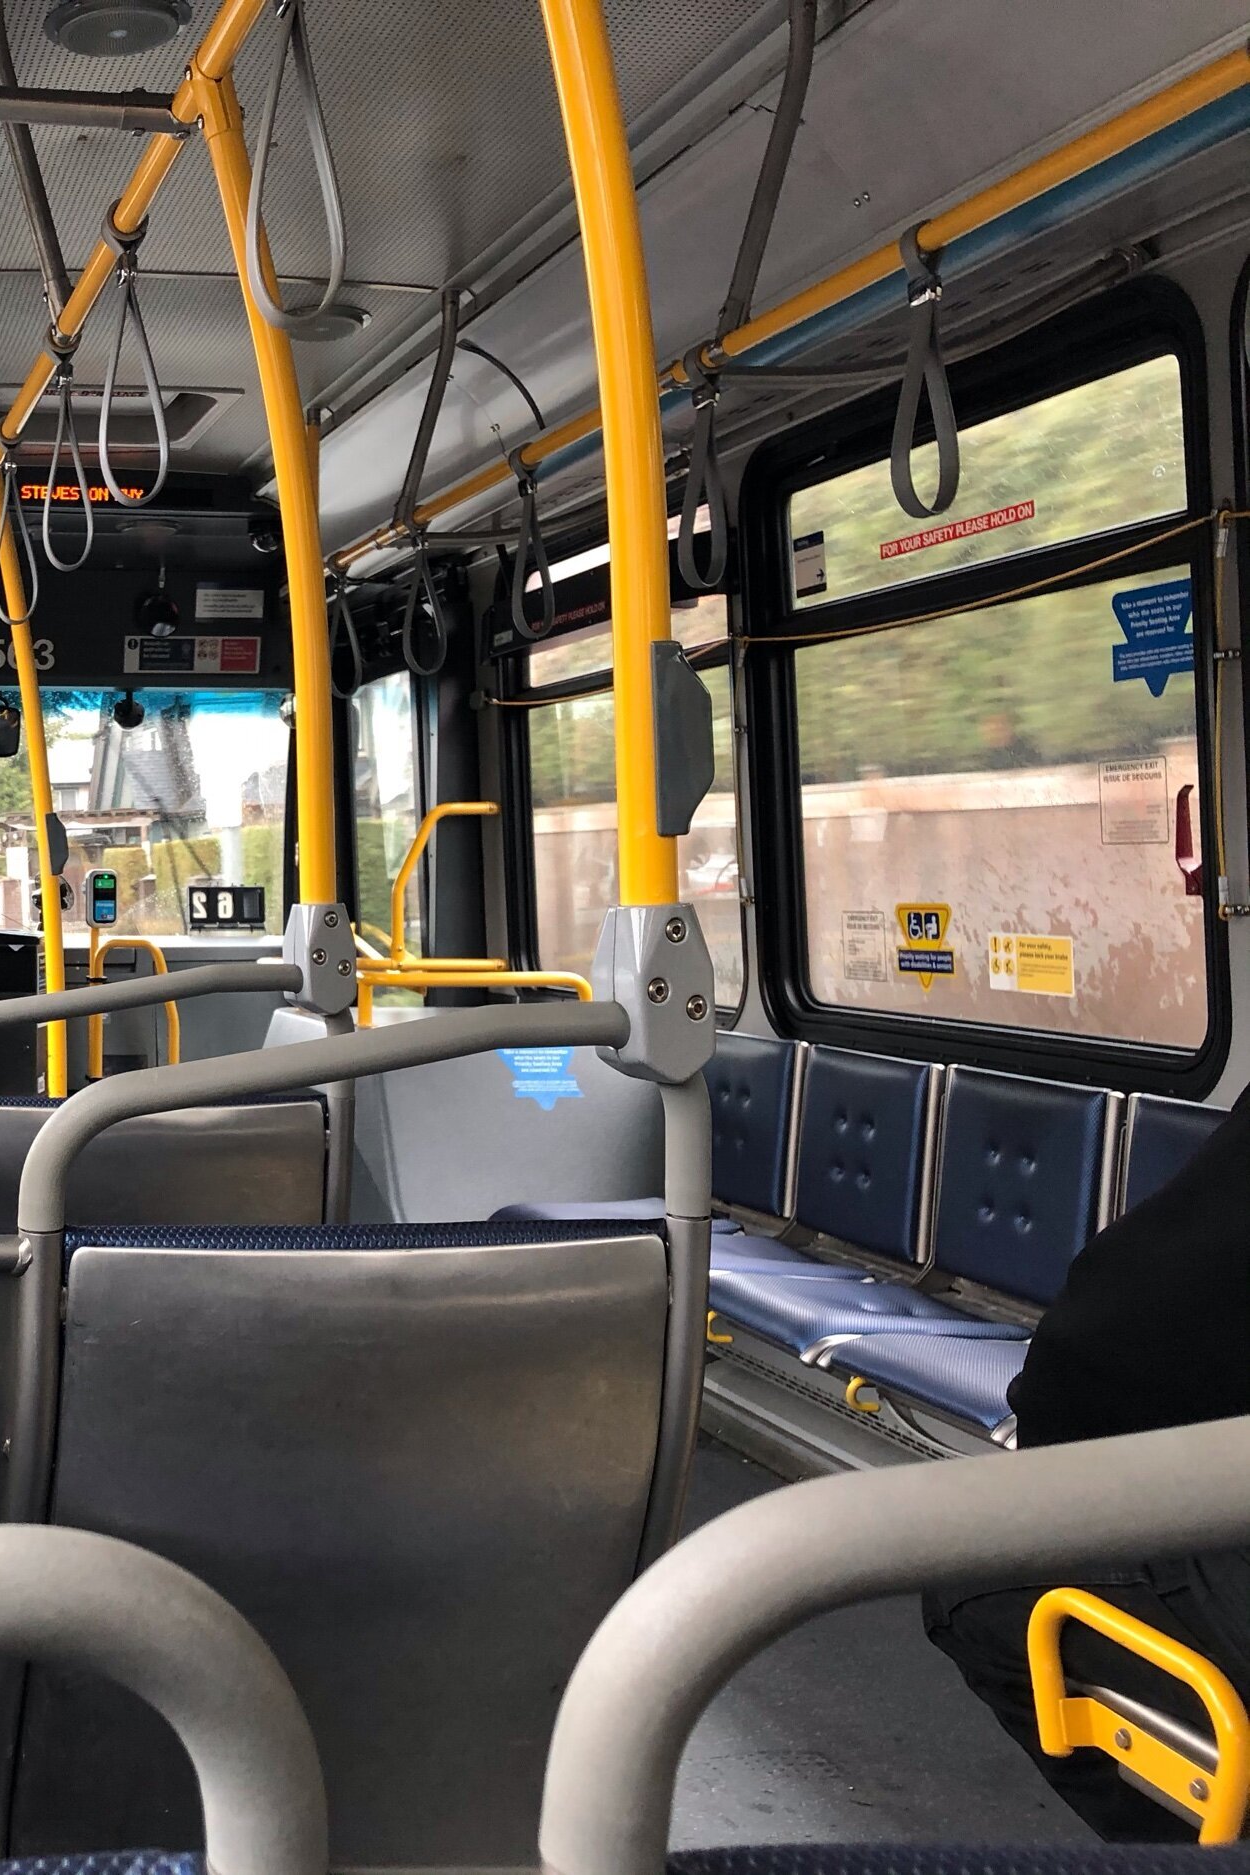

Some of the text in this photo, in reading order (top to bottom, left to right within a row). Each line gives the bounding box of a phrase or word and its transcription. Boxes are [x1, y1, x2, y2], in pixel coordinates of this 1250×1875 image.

[20, 485, 109, 501] STEVESON
[882, 504, 1033, 557] FOR YOUR SAFETY PLEASE HOLD ON
